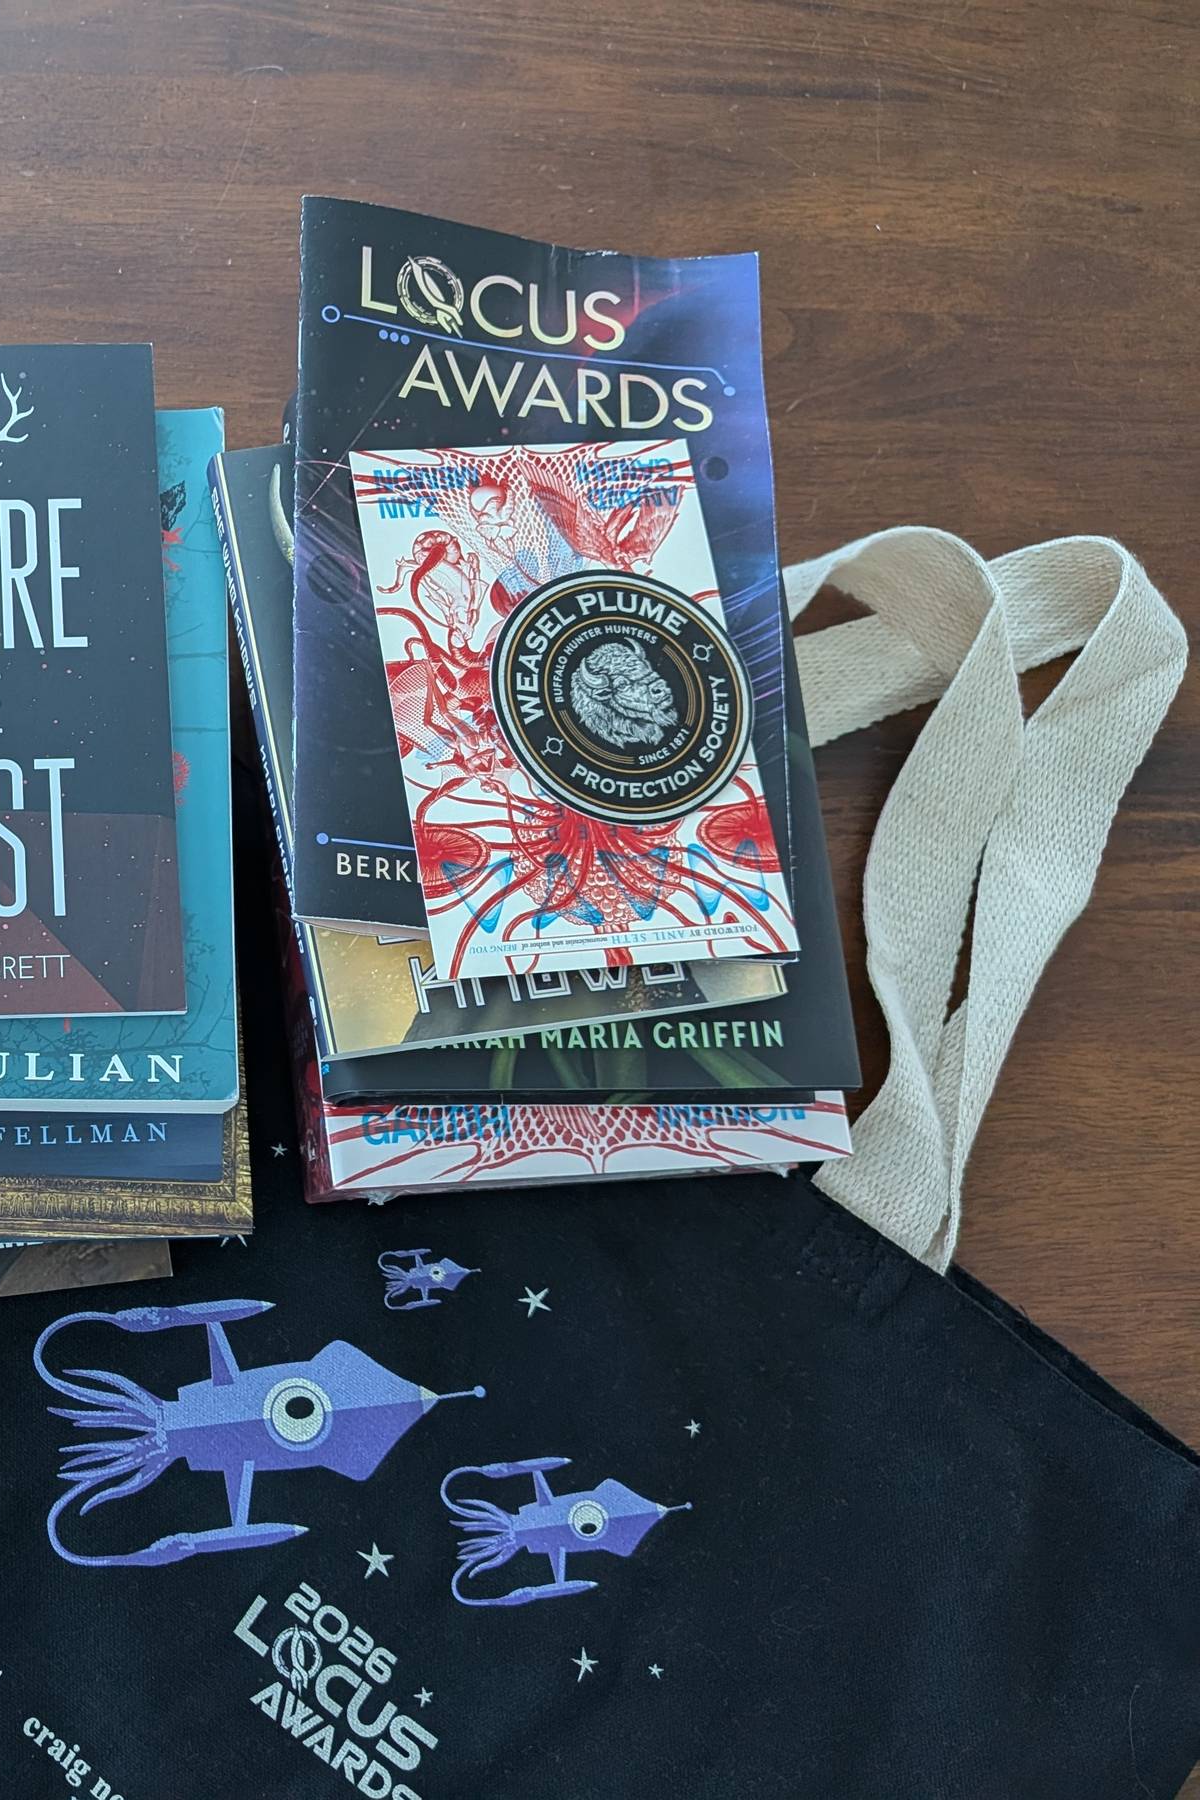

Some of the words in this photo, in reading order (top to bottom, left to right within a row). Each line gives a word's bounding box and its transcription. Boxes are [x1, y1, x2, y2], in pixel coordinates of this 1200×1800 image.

[360, 246, 625, 351] LOCUS
[398, 343, 714, 432] AWARDS
[211, 486, 225, 540] SHE
[377, 496, 439, 519] ZAIN
[516, 607, 576, 725] WEASEL
[575, 591, 688, 635] PLUME
[551, 656, 568, 703] BUFFALO
[564, 626, 603, 655] HUNTER
[604, 625, 658, 645] HUNTERS
[570, 760, 705, 799] PROTECTION
[699, 675, 730, 763] SOCIETY
[638, 749, 671, 766] SINCE
[670, 728, 690, 750] 1871
[530, 940, 551, 949] author
[552, 939, 563, 948] and
[565, 936, 608, 946] neuroscientist
[611, 932, 647, 945] SETH
[652, 929, 685, 942] ANIL
[689, 928, 701, 938] BY
[703, 924, 759, 939] FOREWORD
[469, 945, 488, 955] YOU
[489, 943, 517, 954] BEING
[521, 942, 530, 951] of
[540, 1022, 643, 1050] MARIA
[652, 1020, 784, 1049] GRIFFIN
[284, 1582, 398, 1684] 2026
[233, 1594, 439, 1771] LOCUS
[23, 1717, 91, 1787] craig
